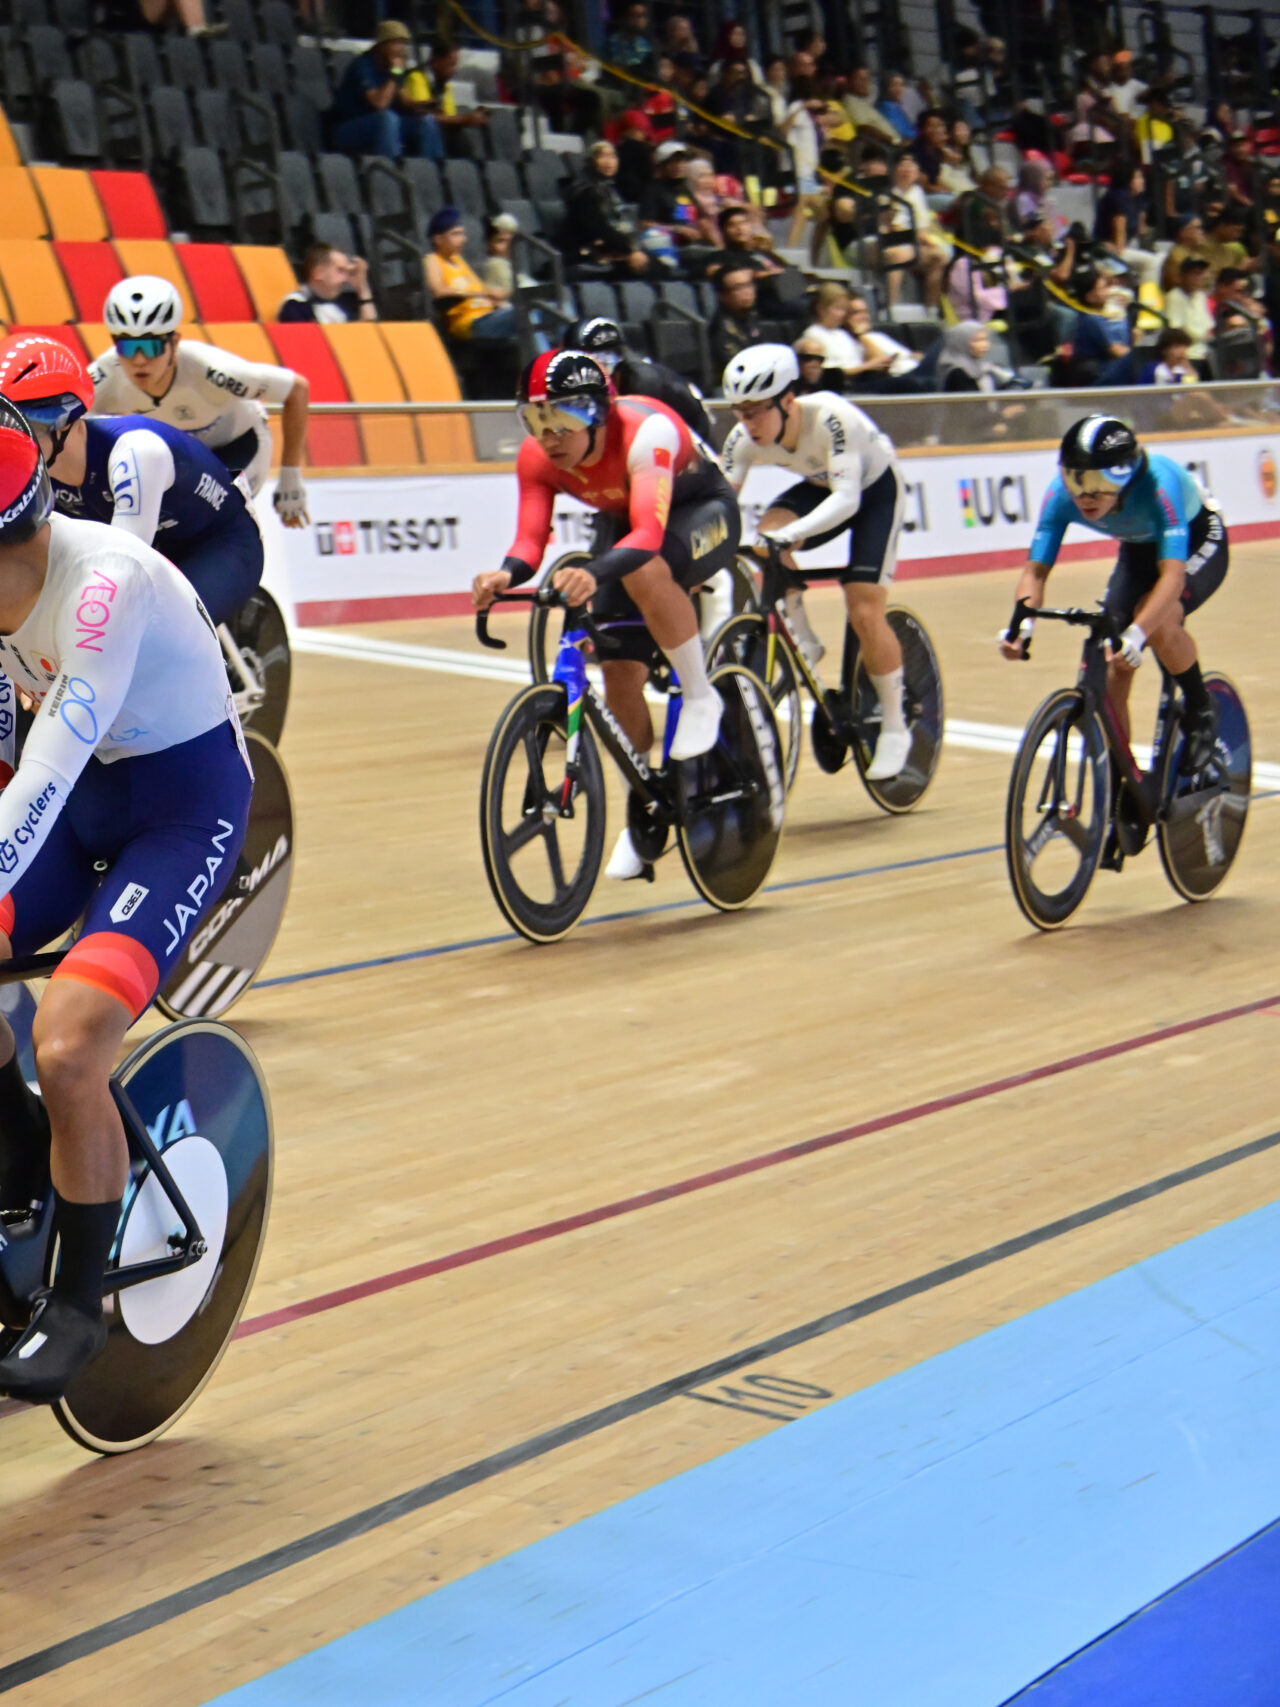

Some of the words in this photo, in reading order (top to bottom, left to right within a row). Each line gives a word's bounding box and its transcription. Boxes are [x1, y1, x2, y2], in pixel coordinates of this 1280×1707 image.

[826, 413, 846, 457] KOREA
[193, 472, 228, 511] FRANCE
[973, 475, 1029, 526] UCI
[358, 516, 460, 554] TISSOT
[48, 673, 70, 718] KEIRIN
[14, 781, 58, 845] Cyclers
[121, 888, 142, 917] Q36.5
[163, 818, 234, 957] JAPAN
[187, 833, 289, 964] CORMA
